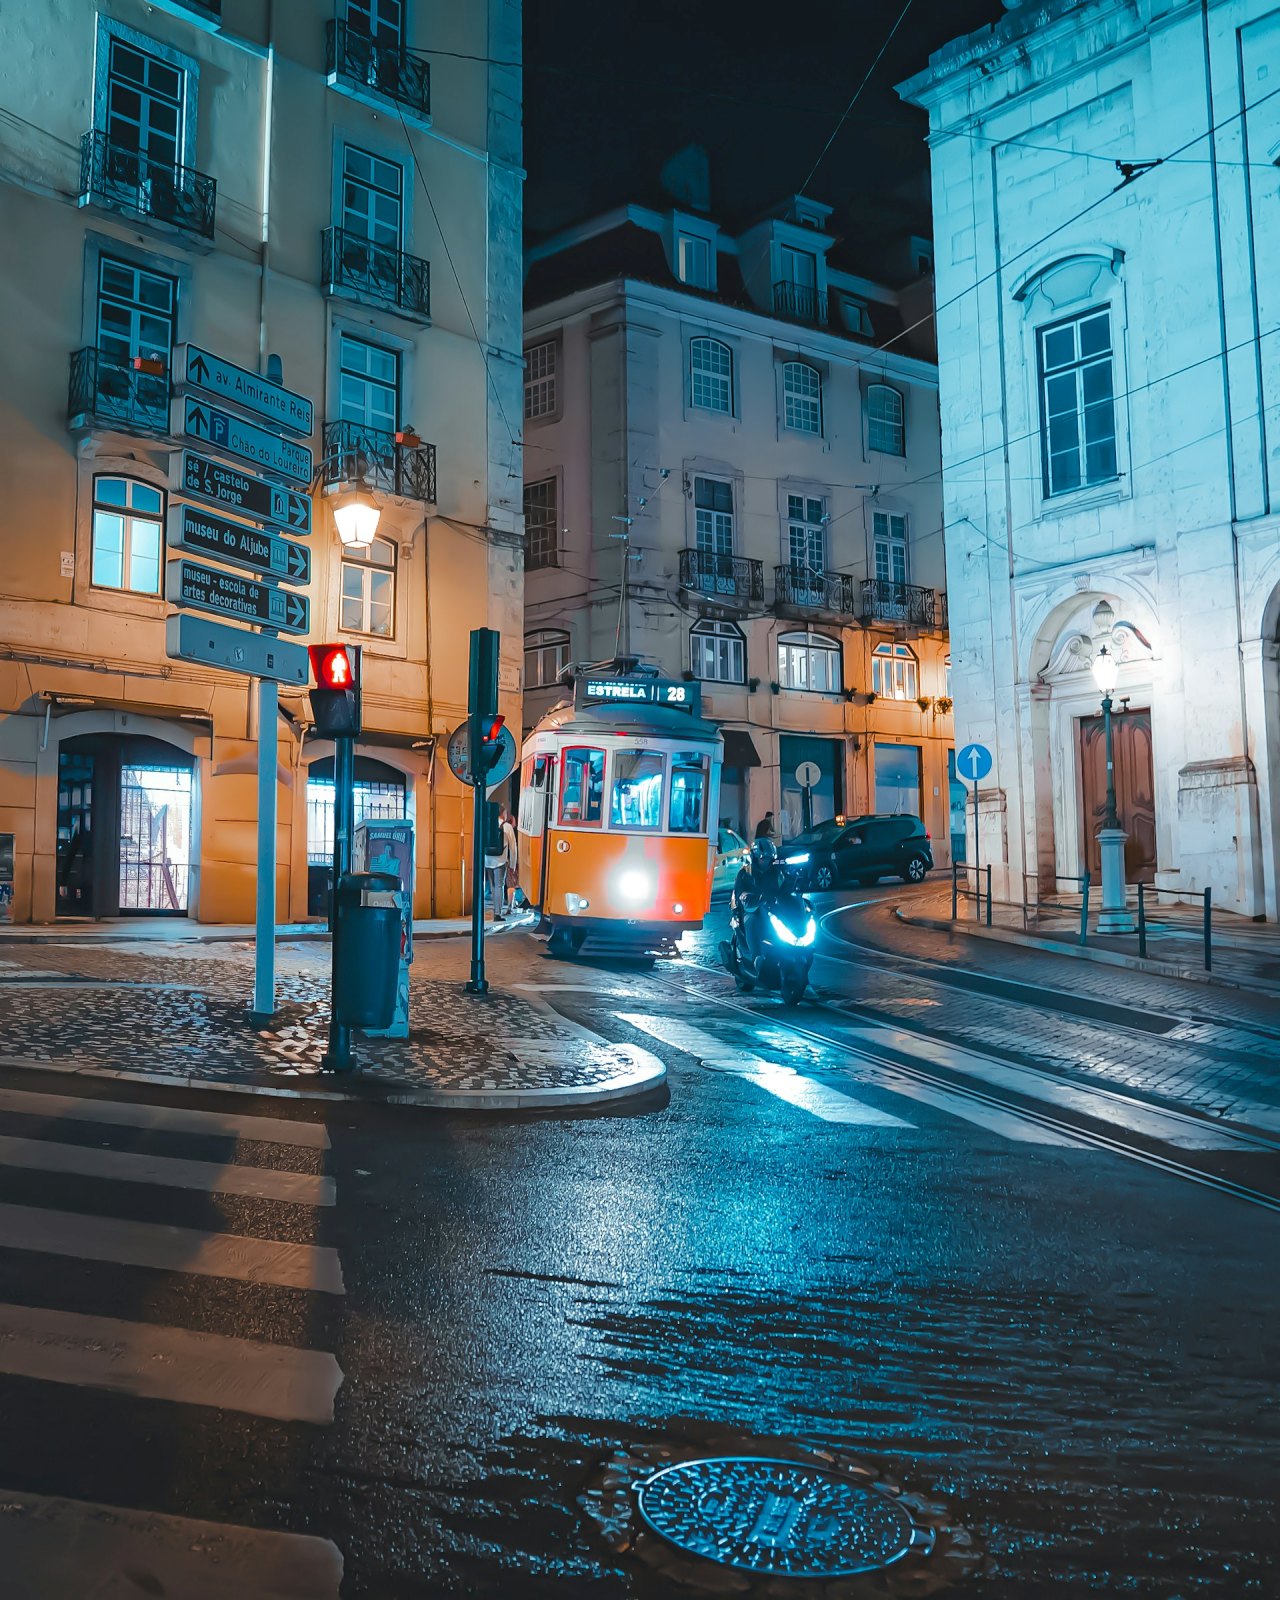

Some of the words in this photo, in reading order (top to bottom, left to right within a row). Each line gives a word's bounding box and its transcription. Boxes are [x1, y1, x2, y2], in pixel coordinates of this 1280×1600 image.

[216, 372, 231, 386] av.
[235, 377, 286, 412] Almirante
[289, 400, 311, 423] Reis
[231, 434, 256, 456] Chão
[259, 448, 270, 461] do
[273, 451, 309, 479] Loureiro
[281, 442, 309, 465] Parque
[187, 459, 199, 473] sé
[213, 470, 250, 492] castelo
[187, 473, 200, 489] de
[204, 479, 214, 494] S.
[215, 483, 242, 505] Jorge
[185, 518, 219, 541] museu
[223, 530, 236, 547] do
[240, 535, 269, 558] Aljube
[183, 566, 211, 586] museu
[219, 577, 246, 596] escola
[249, 586, 259, 600] de
[183, 584, 206, 601] artes
[209, 589, 257, 616] decorativas
[587, 685, 647, 698] ESTRELA
[667, 686, 686, 702] 28
[369, 832, 392, 840] SAMUEL
